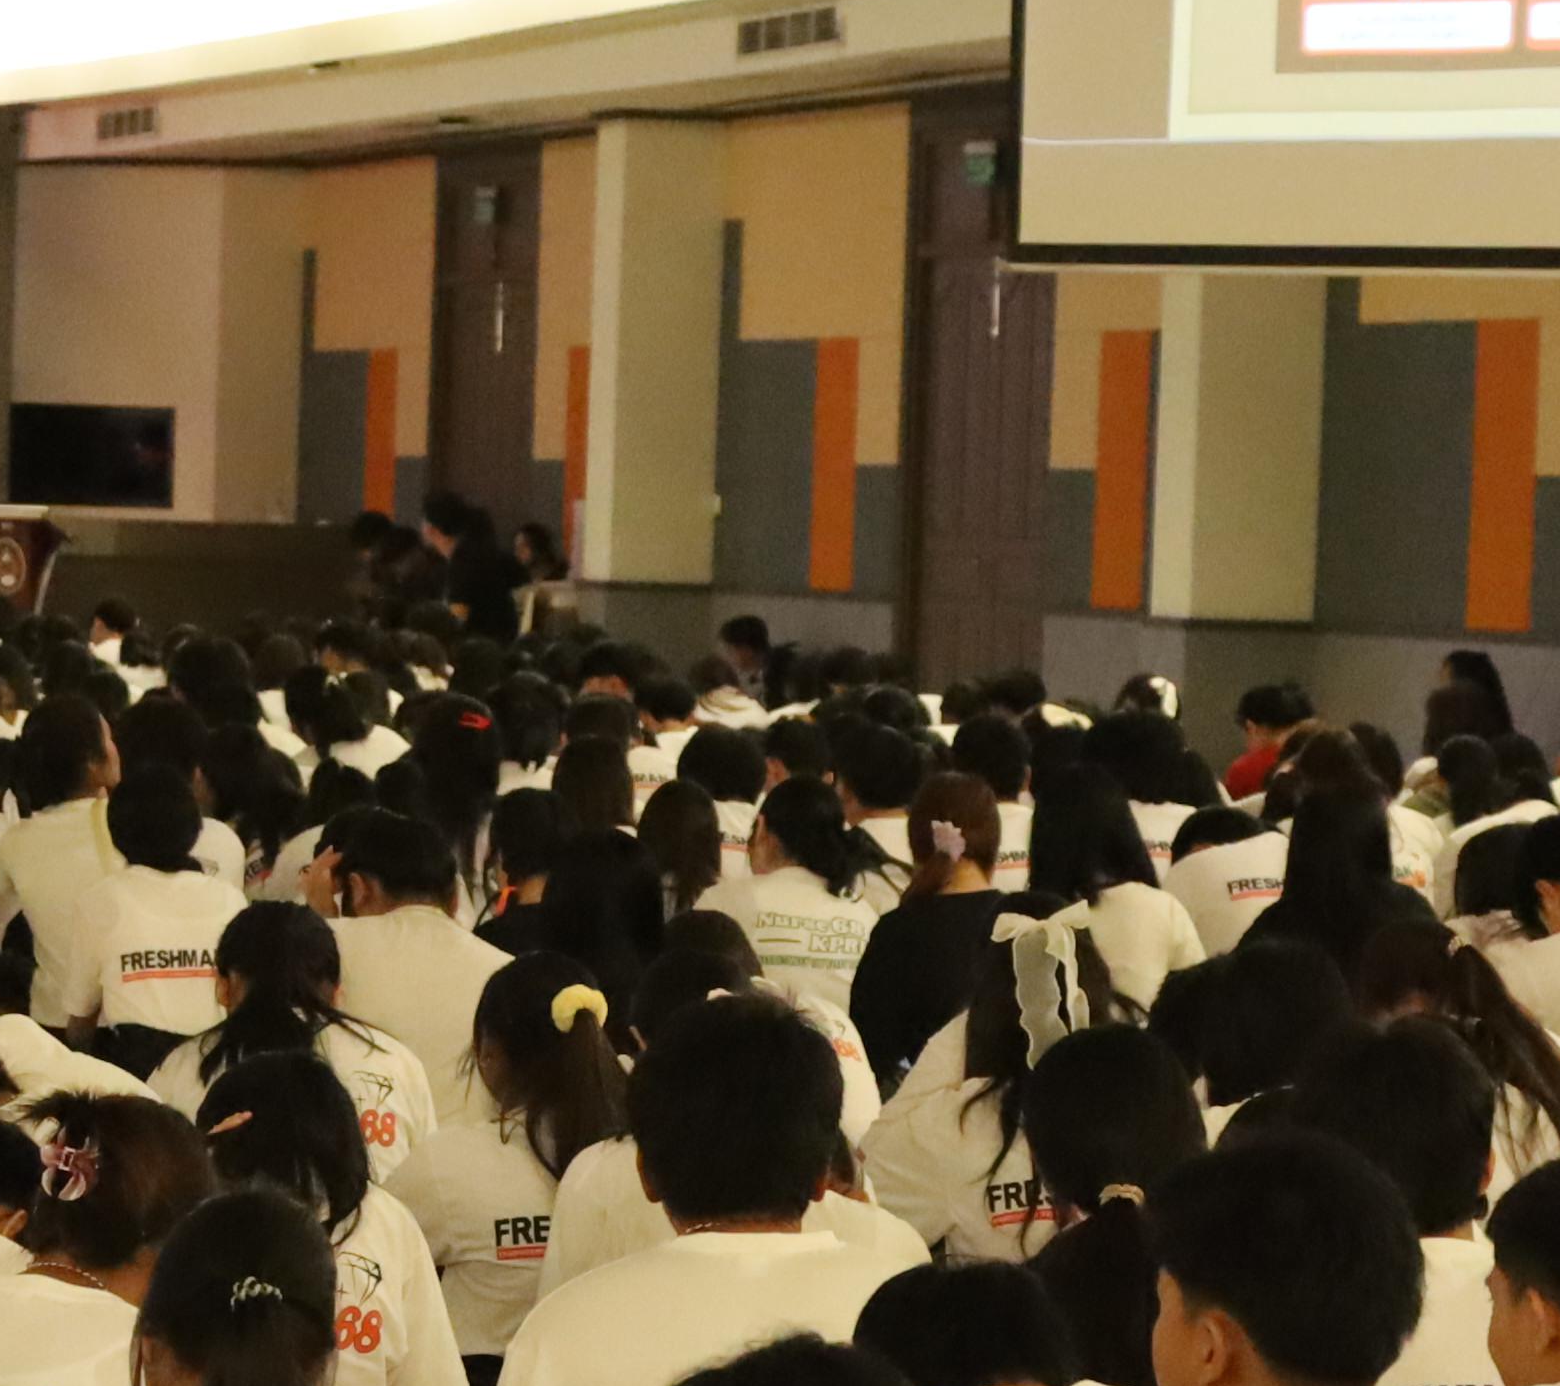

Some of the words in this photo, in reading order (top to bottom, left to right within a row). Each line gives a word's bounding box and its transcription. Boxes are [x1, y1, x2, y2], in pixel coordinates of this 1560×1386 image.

[1227, 878, 1284, 897] FRESH
[808, 933, 865, 955] KPR
[121, 949, 220, 973] FRESHMA
[361, 1109, 396, 1148] 68
[335, 1305, 383, 1354] 68
